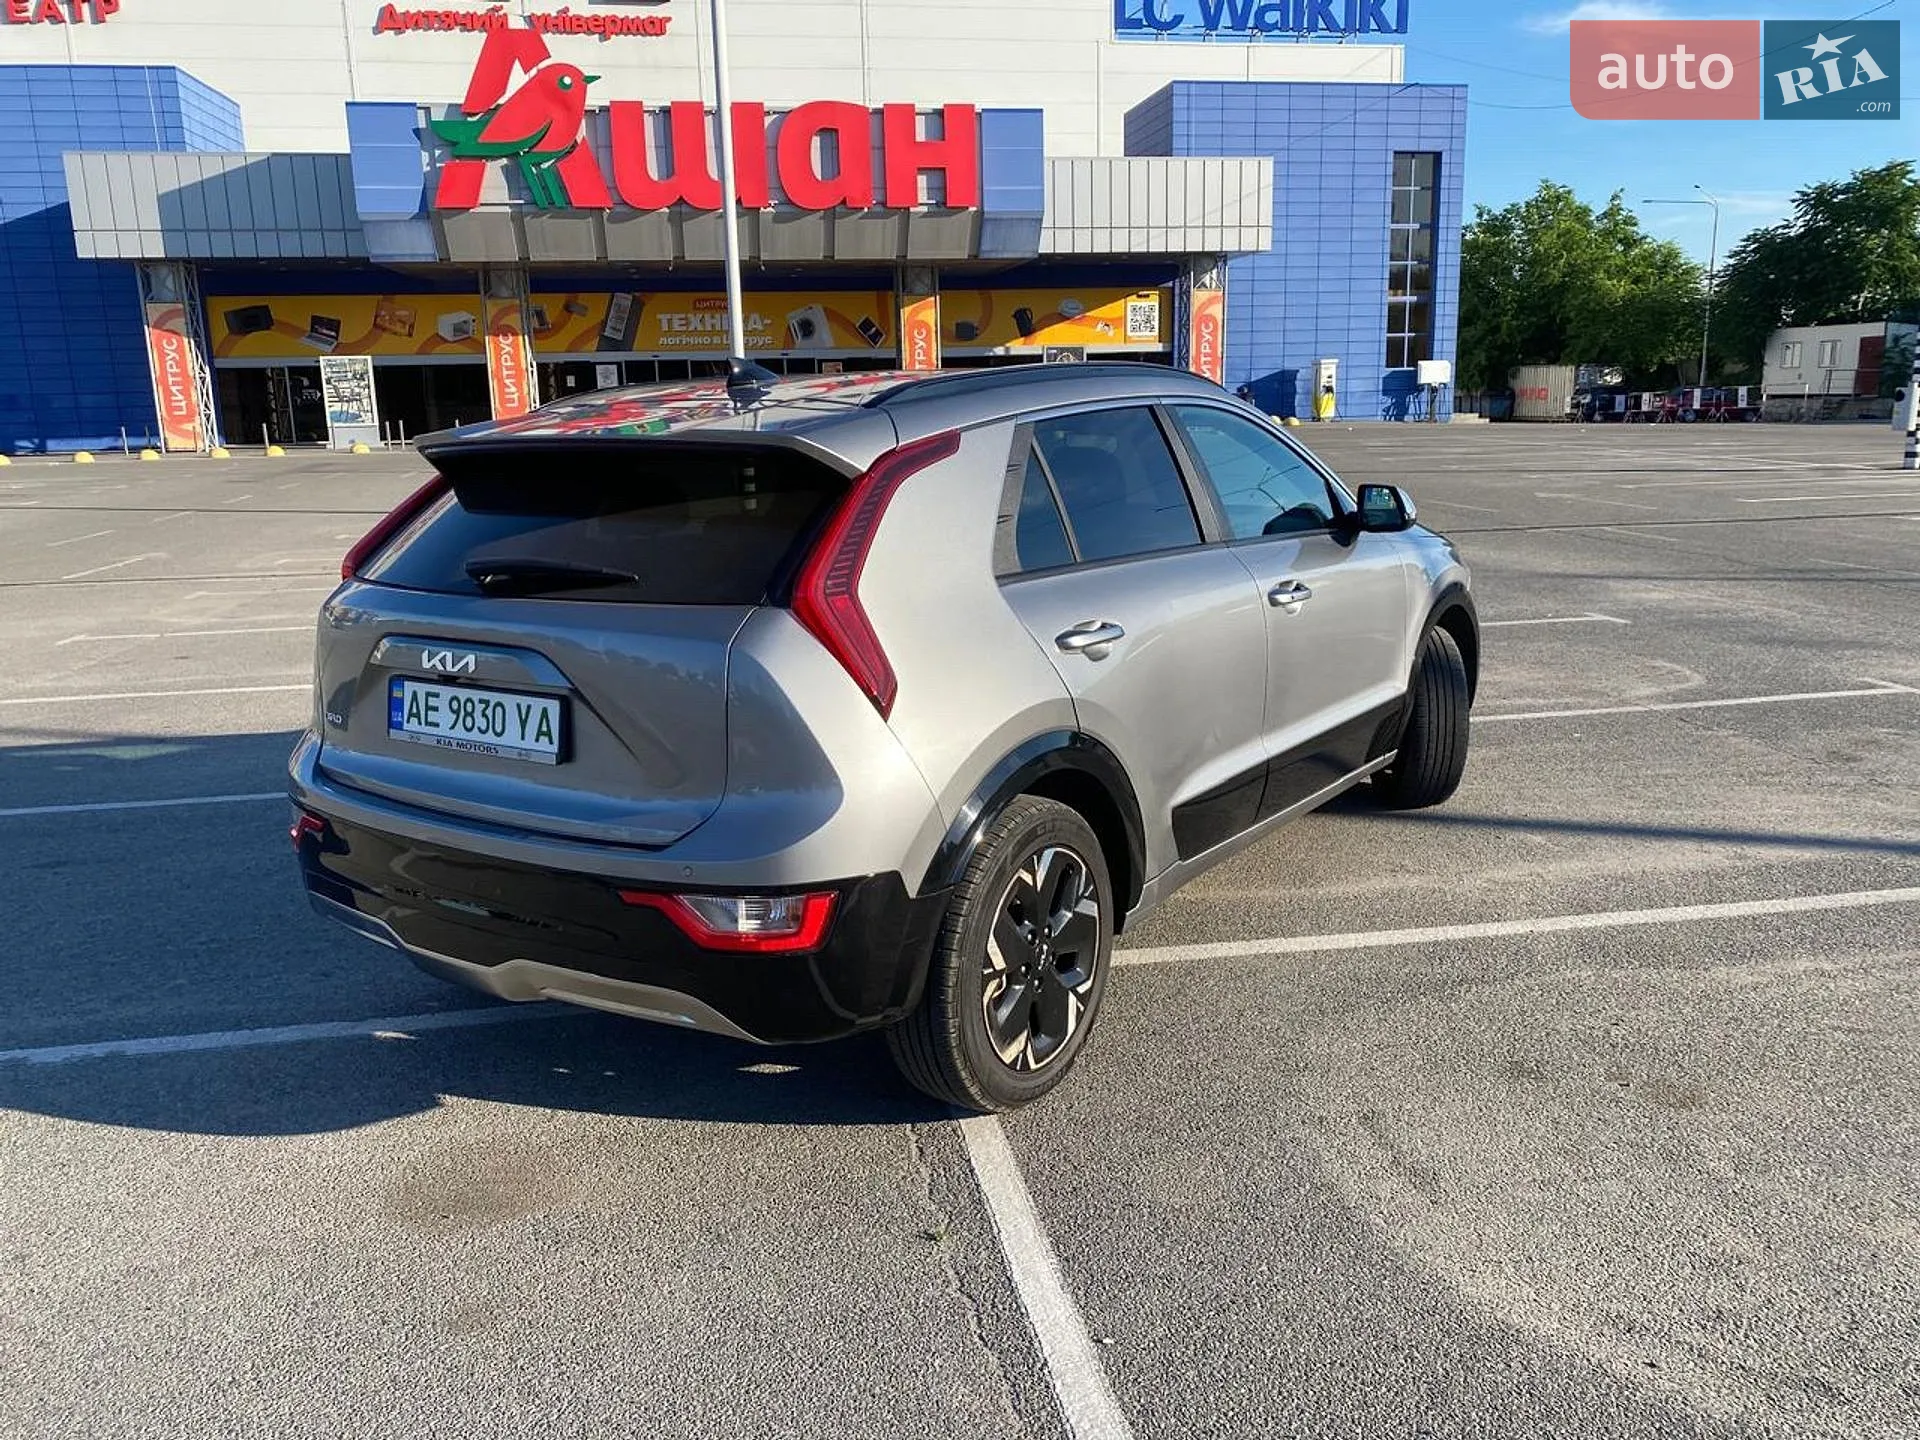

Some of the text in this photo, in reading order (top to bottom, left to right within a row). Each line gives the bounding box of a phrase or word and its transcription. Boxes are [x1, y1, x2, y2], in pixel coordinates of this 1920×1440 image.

[375, 4, 671, 40] Дитячий універмаг
[434, 28, 977, 209] Ашан
[656, 313, 773, 331] ТЕХНІА-
[1200, 320, 1214, 379] ИТРУС
[162, 337, 188, 416] ЦИТРУС
[499, 332, 520, 408] ЦИТРУС
[421, 649, 476, 674] KIA
[406, 689, 554, 746] AE 9830 YA
[436, 738, 500, 755] KIA MOTORS
